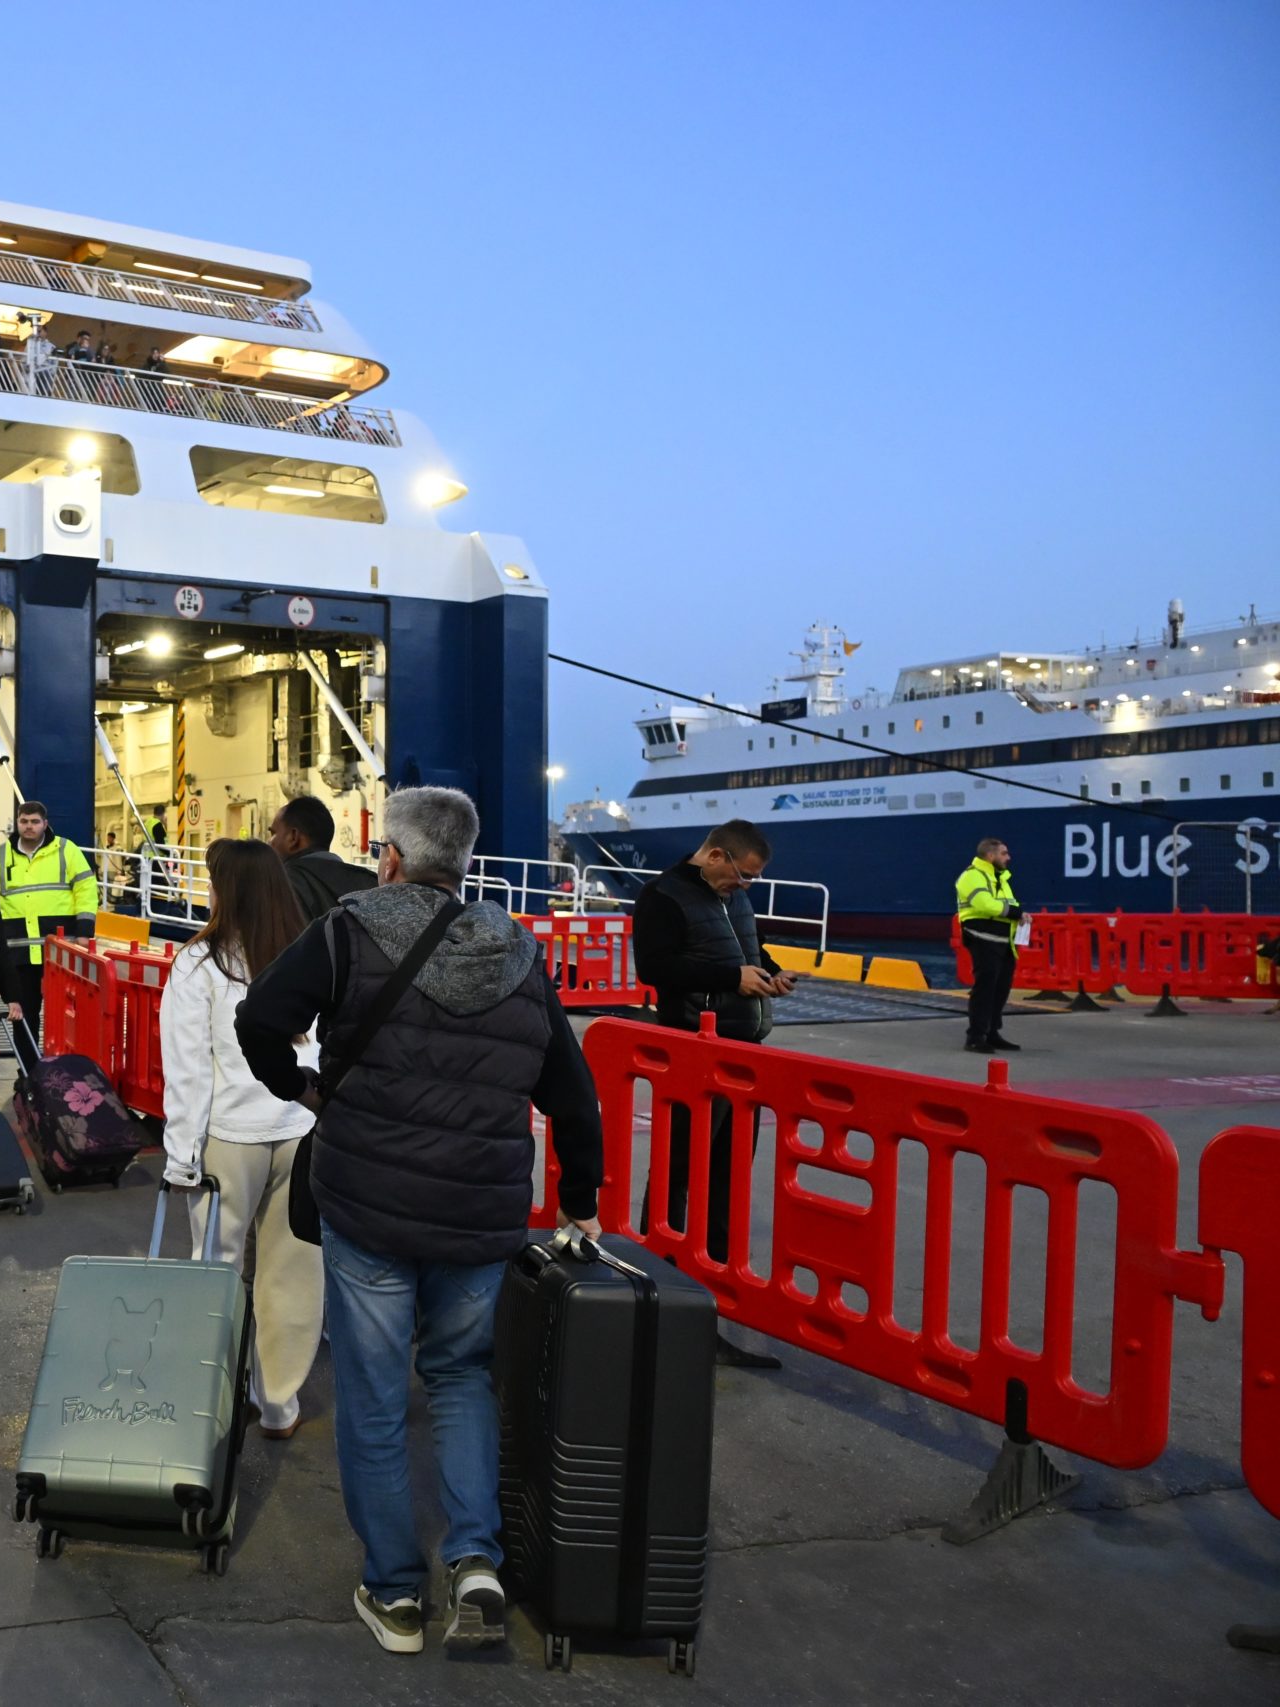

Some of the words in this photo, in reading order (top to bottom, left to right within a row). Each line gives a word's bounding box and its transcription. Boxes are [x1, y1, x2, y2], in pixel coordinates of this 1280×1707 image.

[190, 803, 199, 818] 10
[1064, 821, 1192, 877] Blue
[1235, 817, 1280, 875] S
